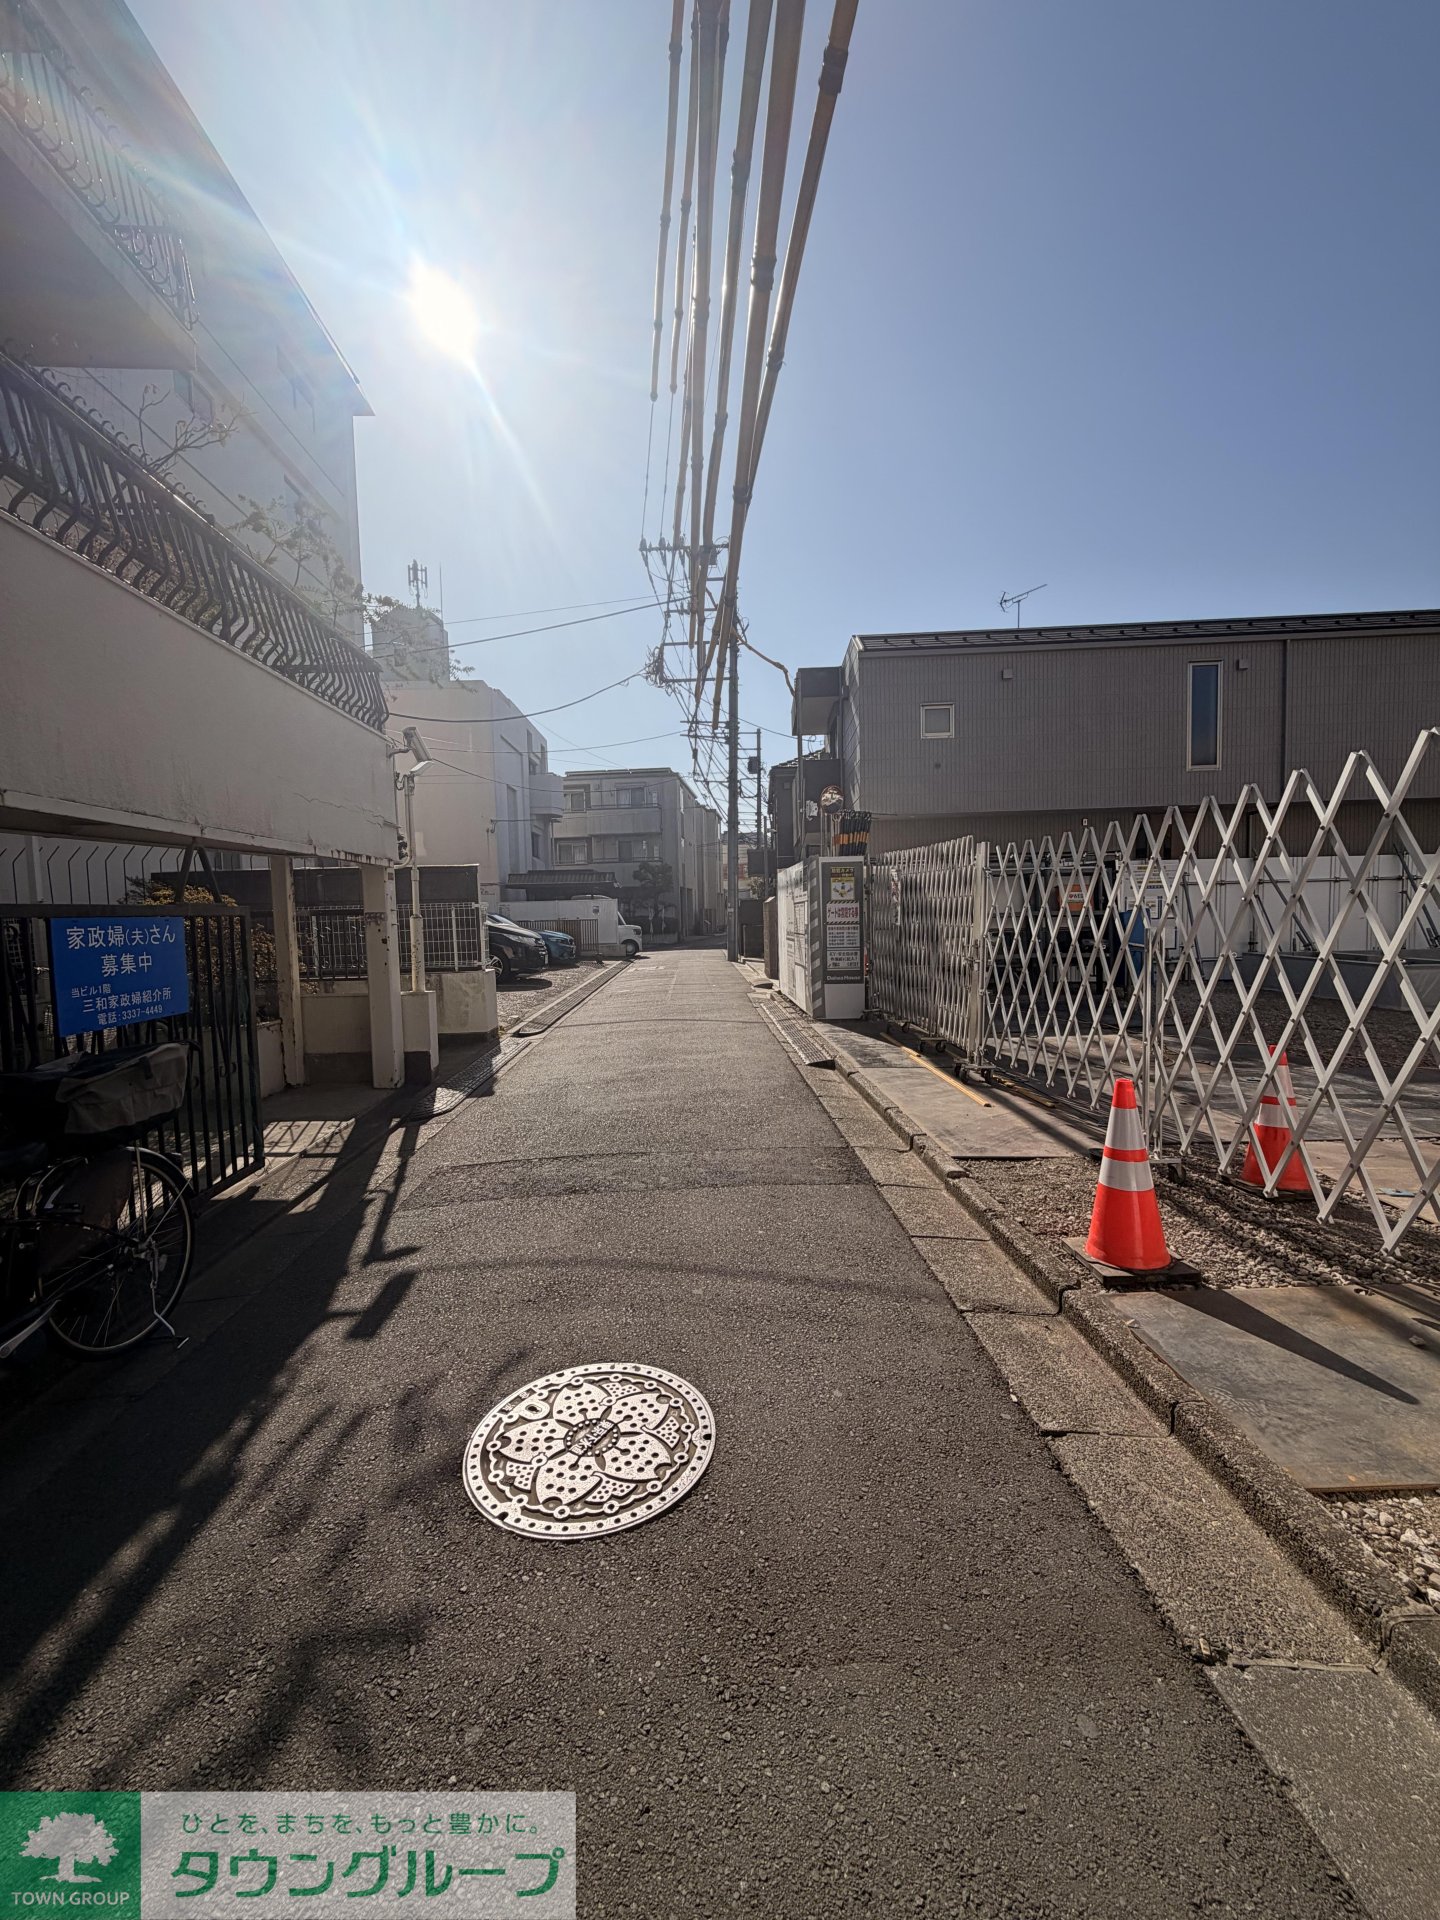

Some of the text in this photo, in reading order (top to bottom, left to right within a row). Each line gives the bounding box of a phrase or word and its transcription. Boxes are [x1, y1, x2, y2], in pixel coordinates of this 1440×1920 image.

[66, 924, 176, 950] 家政婦(夫)さん
[101, 952, 153, 978] 募集中
[71, 984, 112, 999] 当ビル1階
[83, 987, 172, 1013] 三和家政婦紹介所
